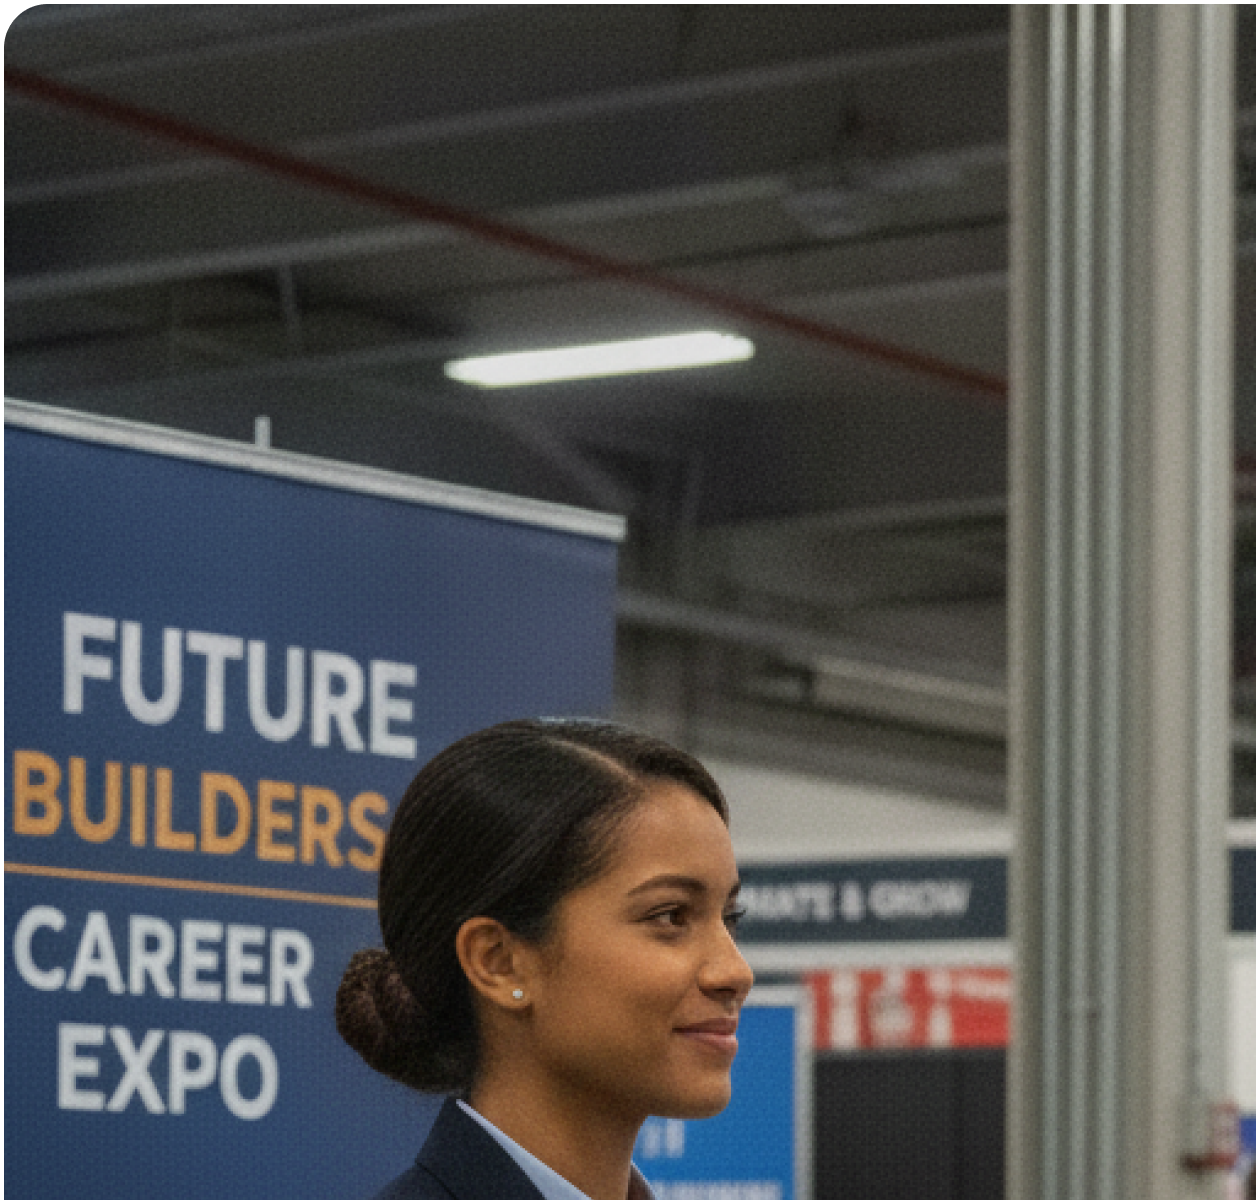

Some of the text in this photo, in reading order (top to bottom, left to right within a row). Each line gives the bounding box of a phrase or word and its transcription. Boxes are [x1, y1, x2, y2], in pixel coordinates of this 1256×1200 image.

[63, 611, 418, 760] FUTURE
[12, 749, 391, 872] BUILDERS
[13, 905, 315, 1009] CAREER
[57, 1023, 280, 1120] EXPO
